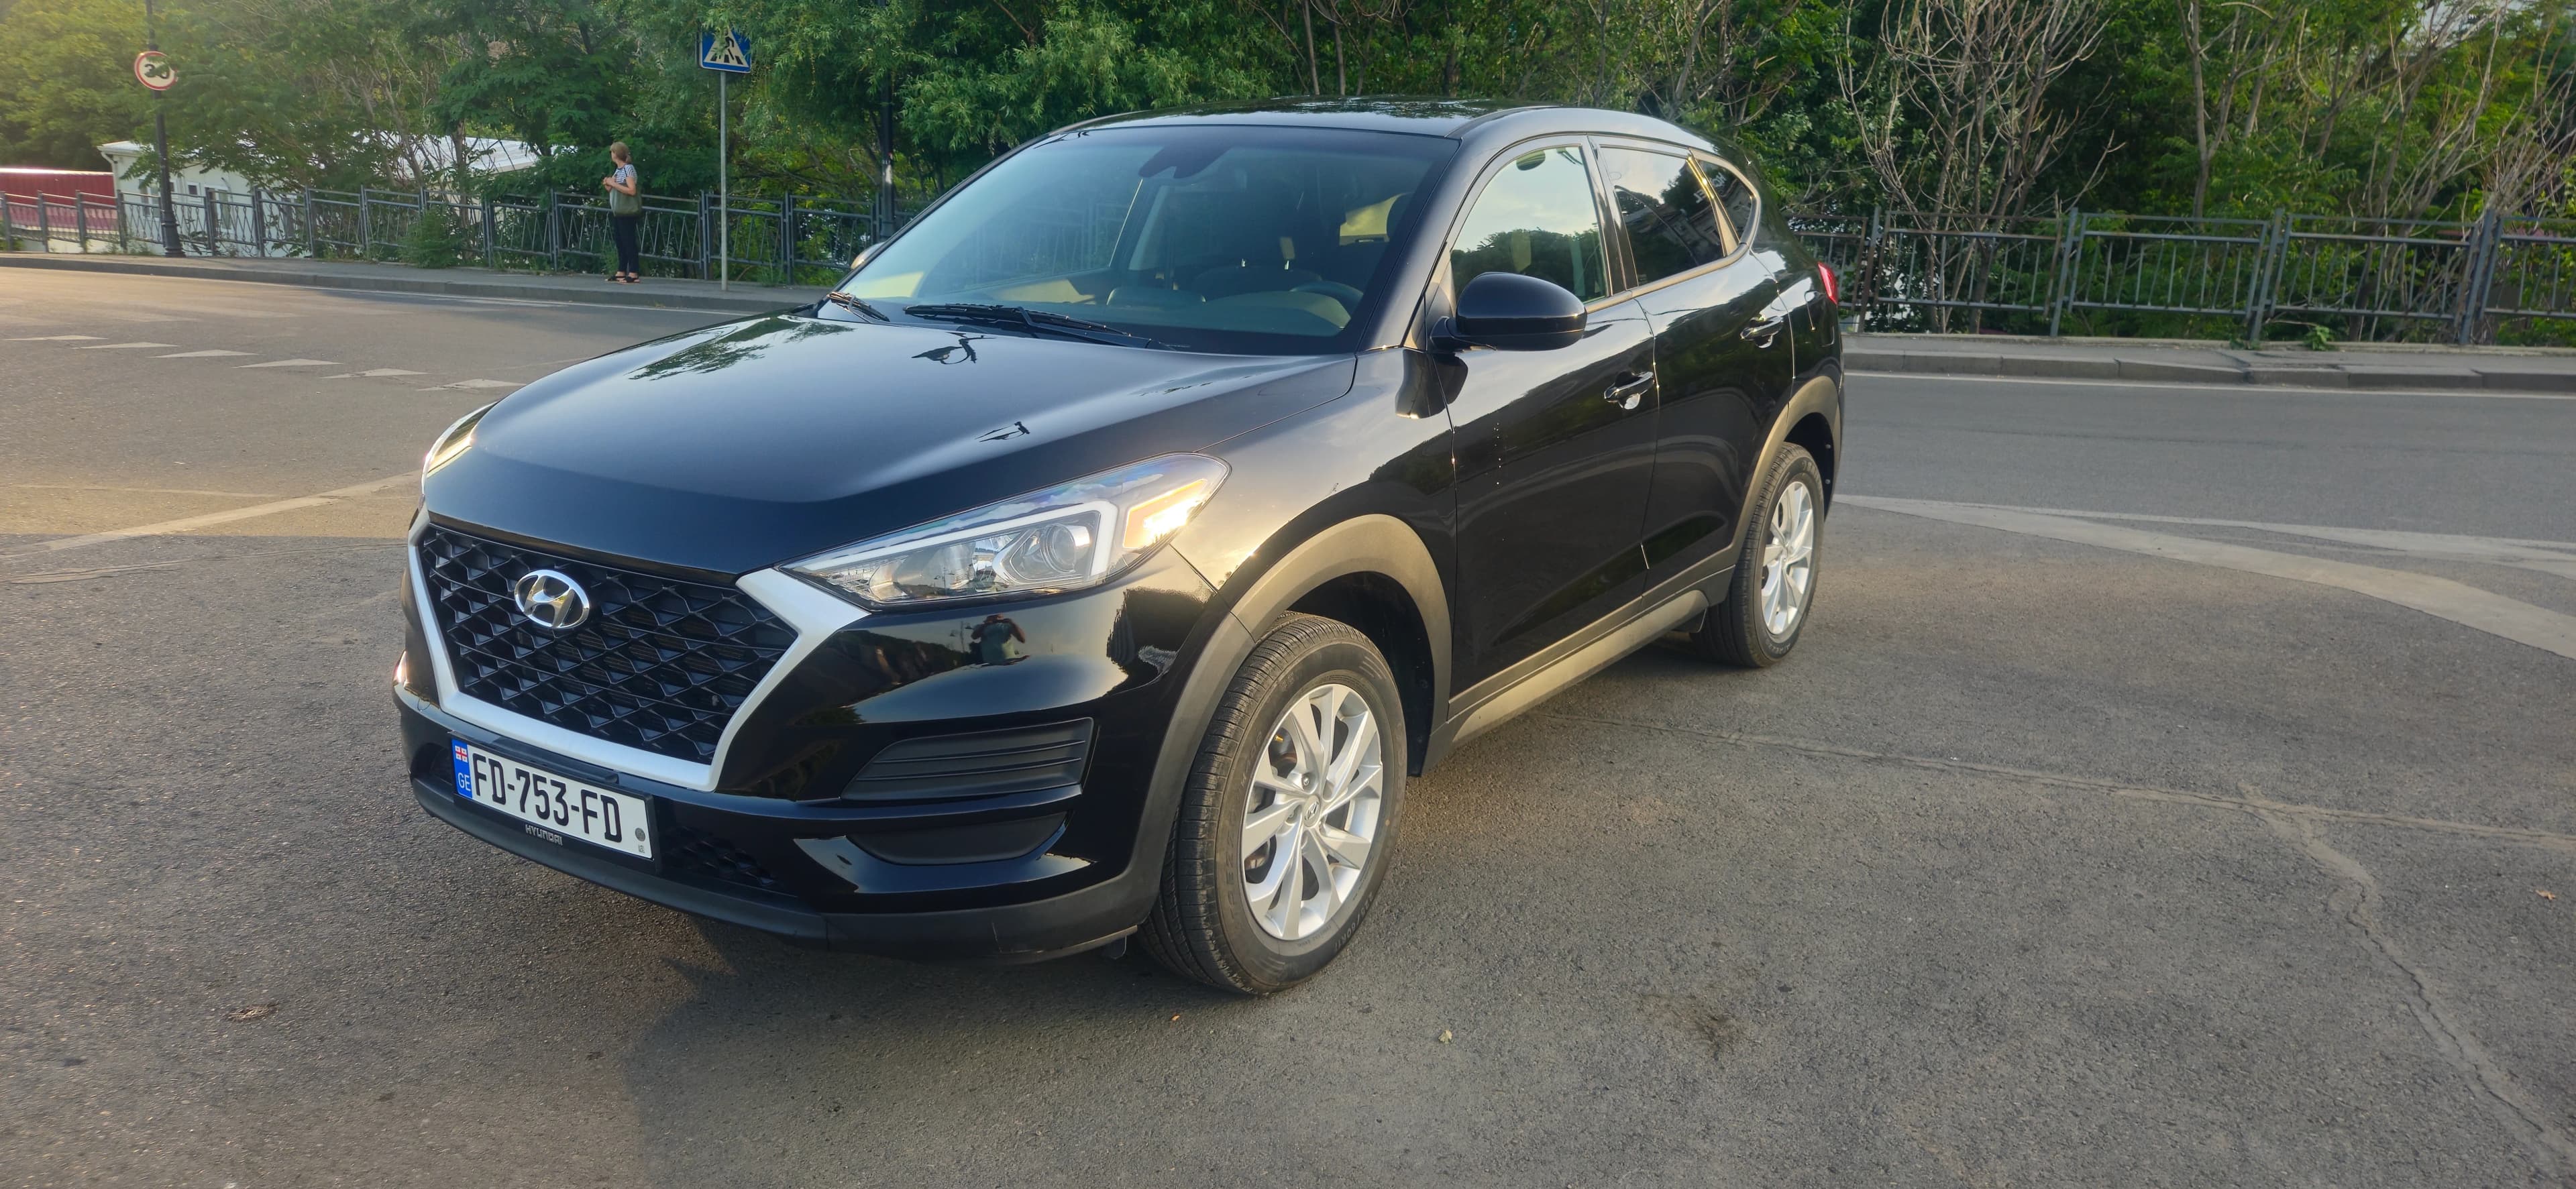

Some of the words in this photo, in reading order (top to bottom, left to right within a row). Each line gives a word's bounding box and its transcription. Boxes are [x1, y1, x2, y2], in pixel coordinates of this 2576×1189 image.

[458, 773, 472, 791] GE
[472, 752, 623, 844] FD-753-FD
[525, 824, 562, 846] HYUNDAI
